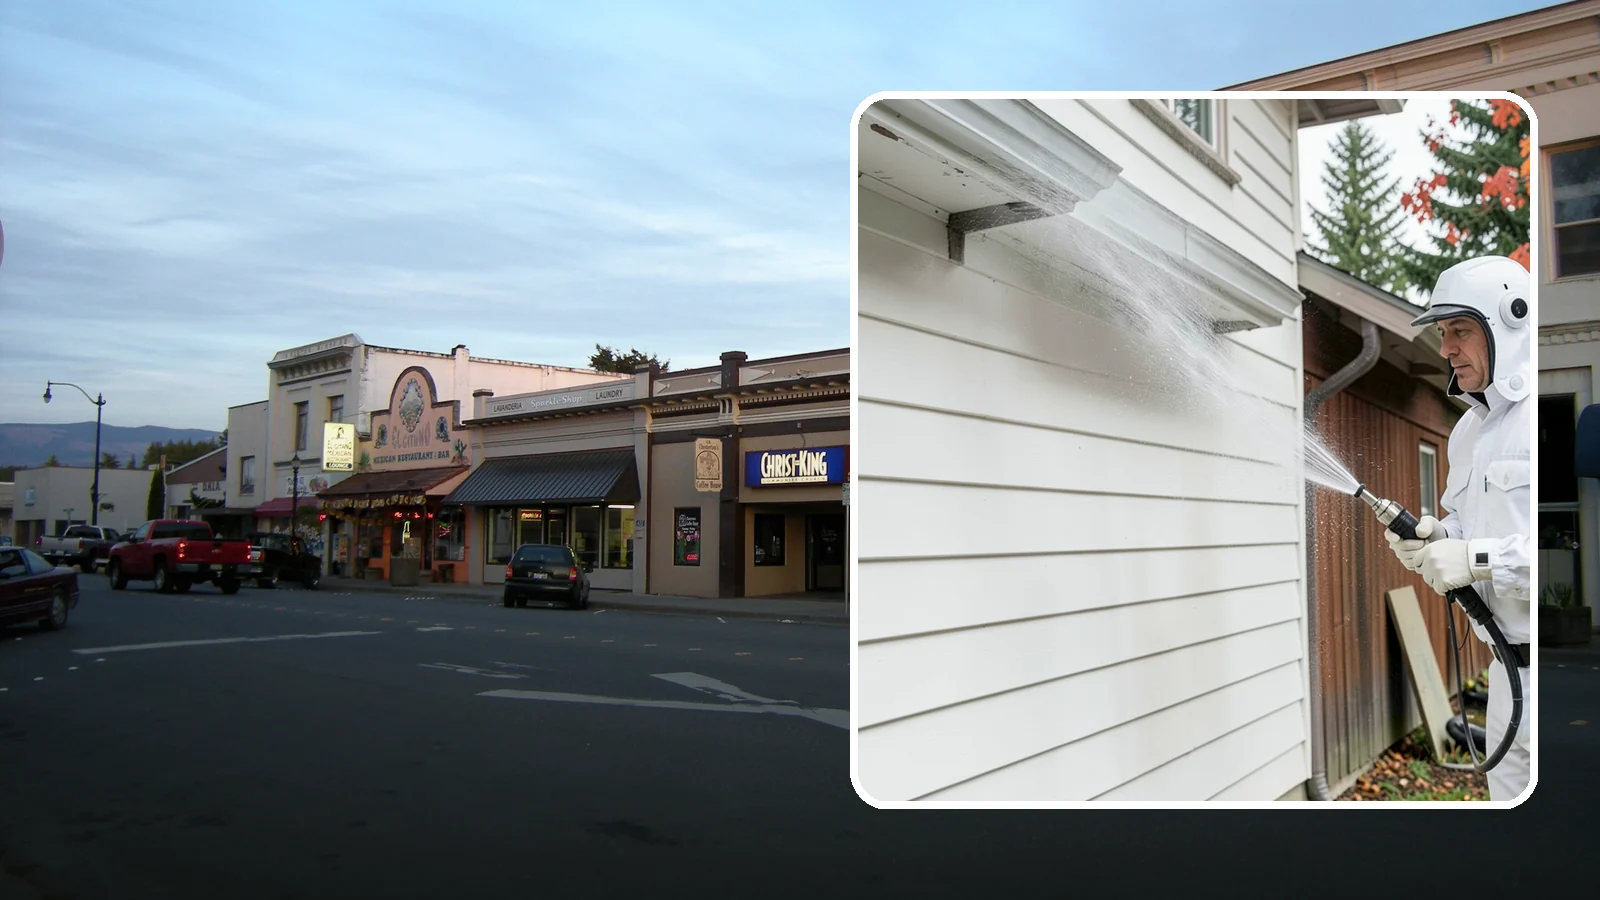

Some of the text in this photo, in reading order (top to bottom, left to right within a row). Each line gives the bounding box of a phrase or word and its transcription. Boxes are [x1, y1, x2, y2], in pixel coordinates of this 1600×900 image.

[530, 394, 582, 408] Sparkle Shop
[595, 389, 623, 400] LAUNDRY
[494, 402, 522, 412] LAVANDERIA
[392, 425, 401, 449] EL
[374, 455, 396, 464] MEXICAN
[398, 452, 433, 462] RESTAURANT
[438, 450, 450, 458] BAR
[760, 450, 827, 478] CHRIST KING
